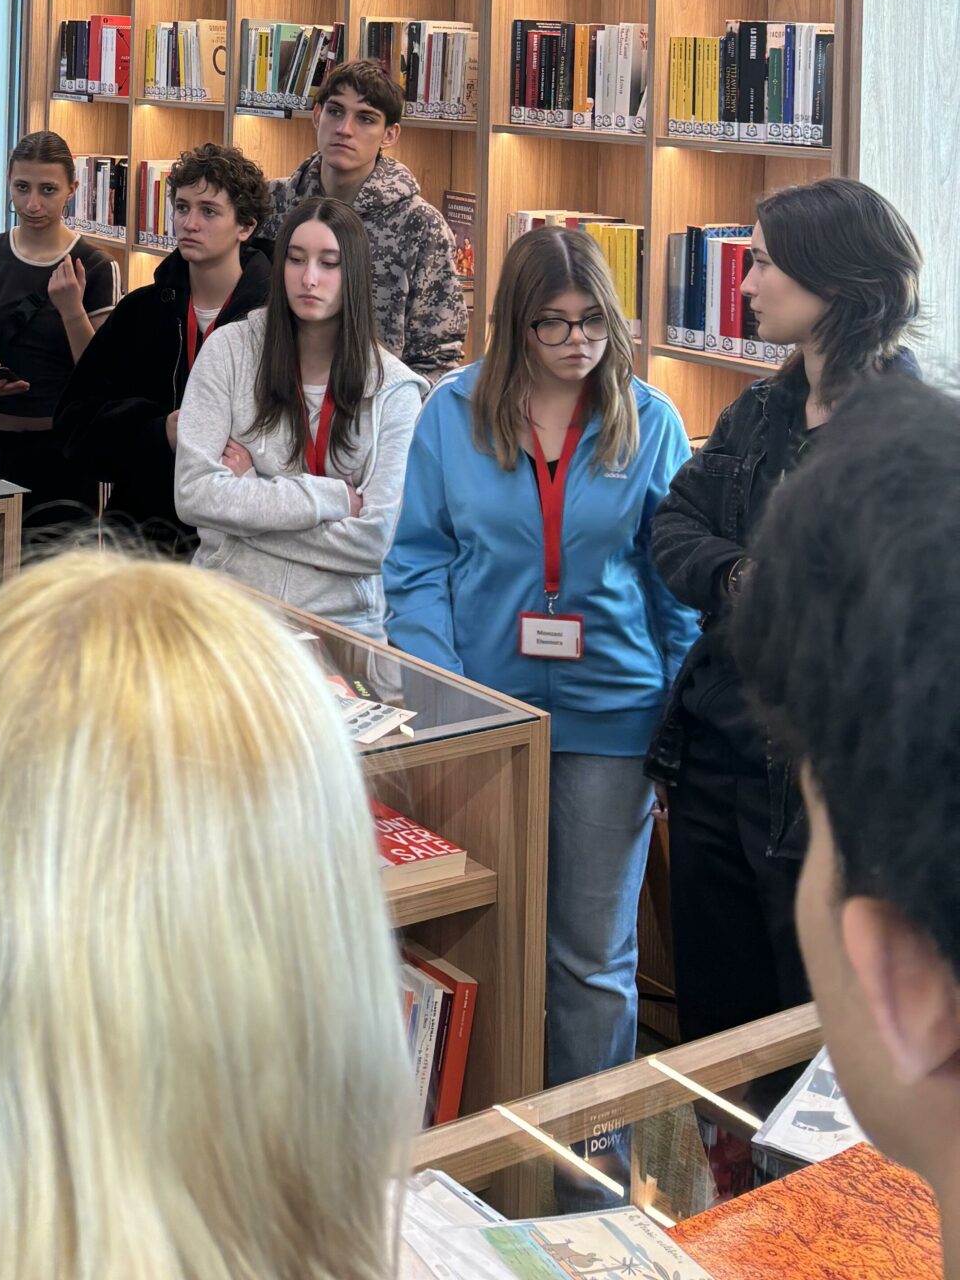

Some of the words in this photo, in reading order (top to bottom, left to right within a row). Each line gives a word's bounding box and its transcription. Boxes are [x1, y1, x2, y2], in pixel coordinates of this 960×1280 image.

[749, 35, 757, 60] STAZIONE
[375, 817, 420, 833] UNI
[383, 828, 441, 846] VER
[390, 840, 464, 862] SALE
